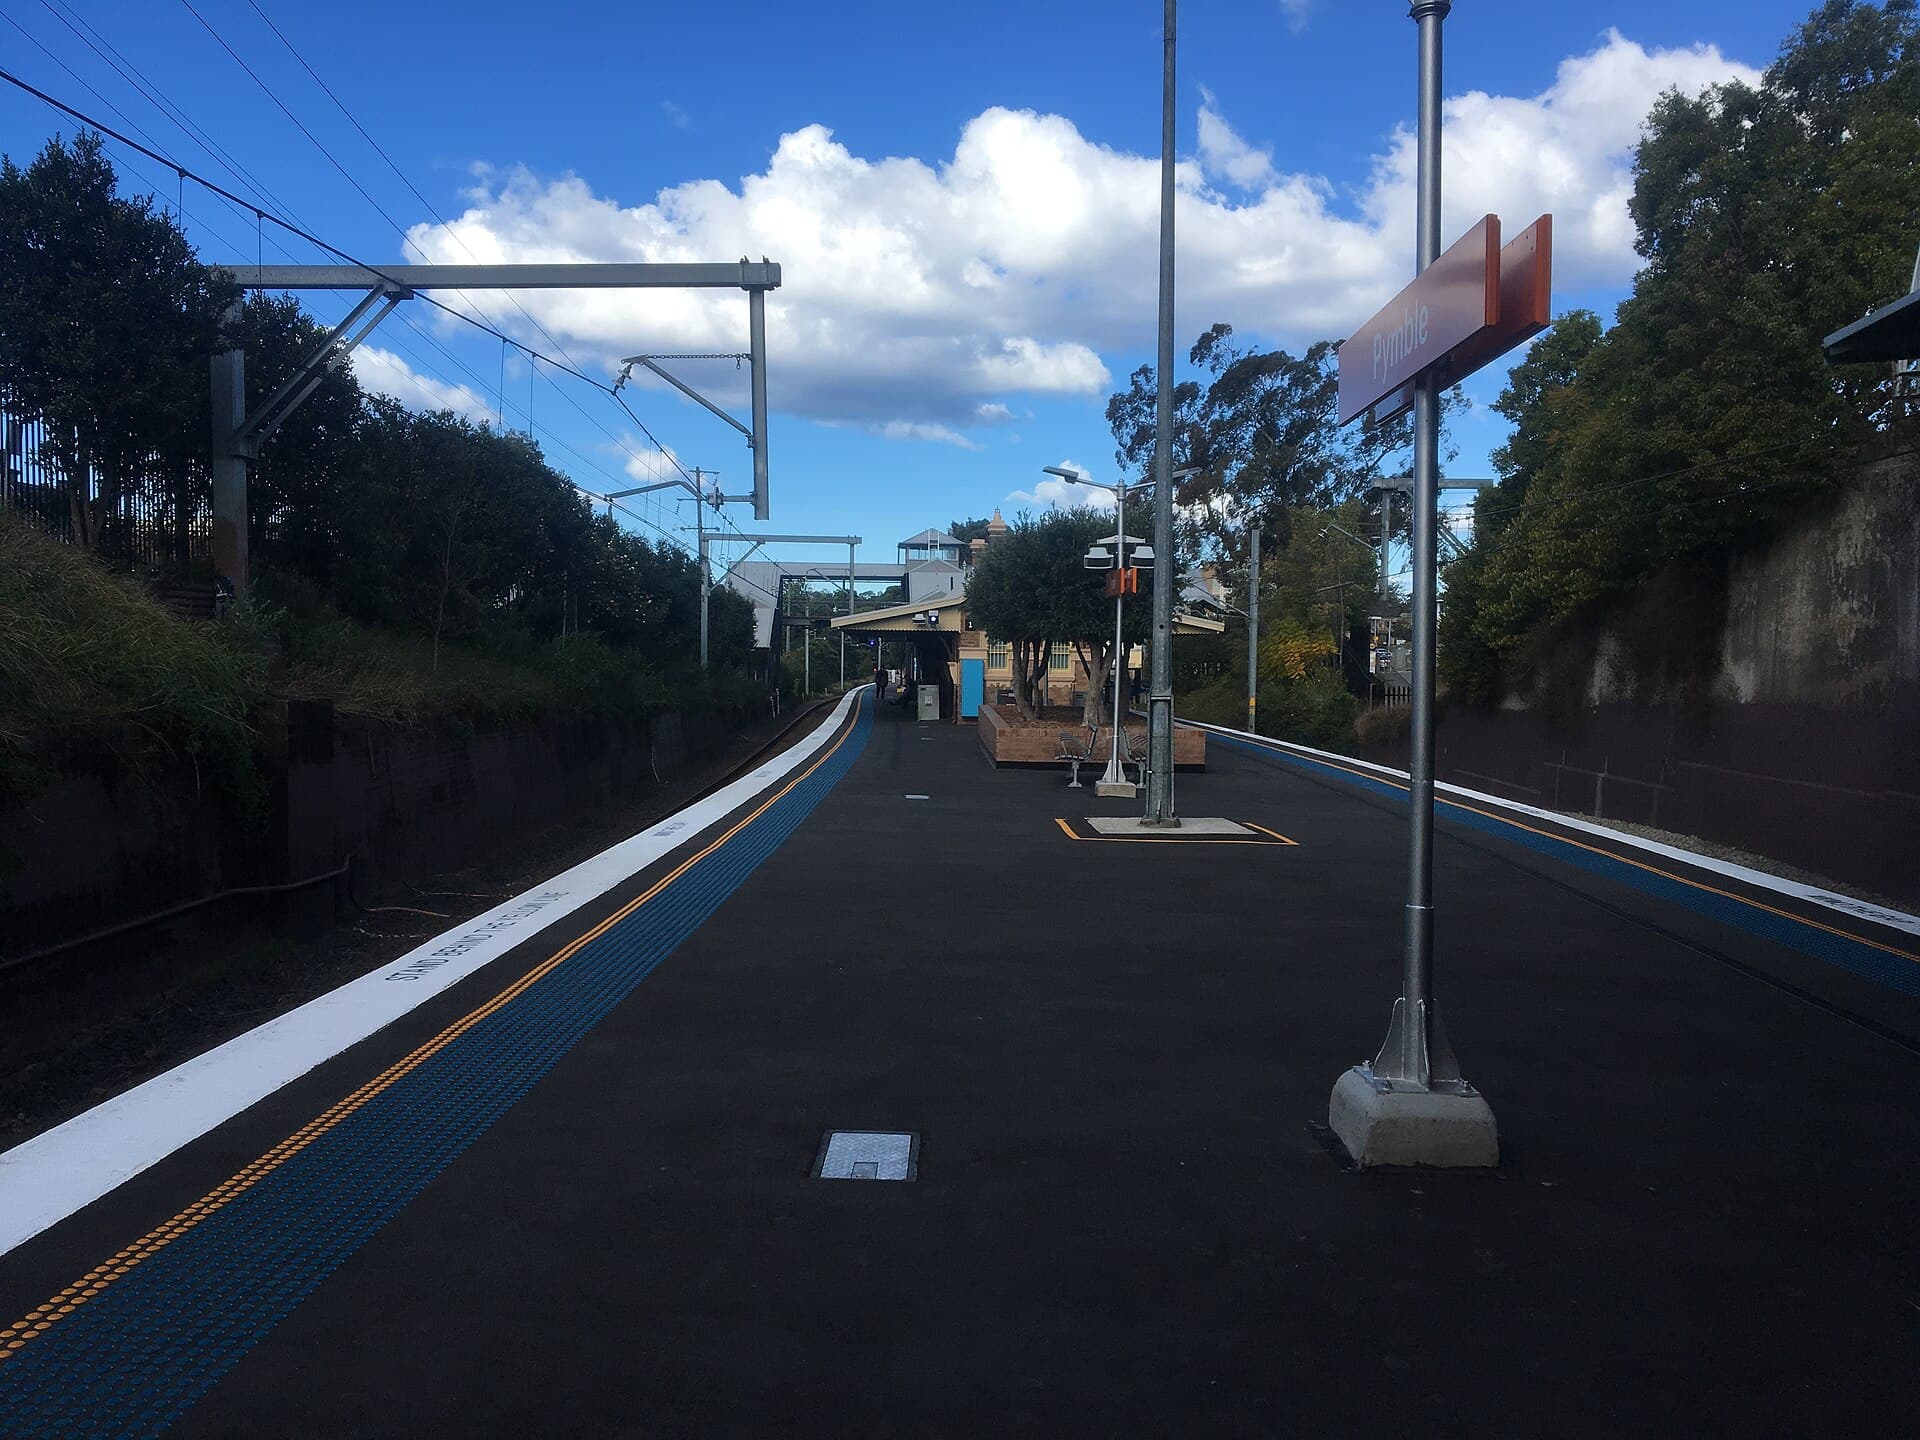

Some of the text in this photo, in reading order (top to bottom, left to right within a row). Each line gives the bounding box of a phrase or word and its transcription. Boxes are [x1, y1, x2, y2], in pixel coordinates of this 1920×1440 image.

[1373, 299, 1429, 384] Pymble
[385, 958, 449, 981] STAND
[430, 934, 493, 956] BEHIND
[474, 922, 516, 933] THE
[495, 902, 550, 921] YELLOW
